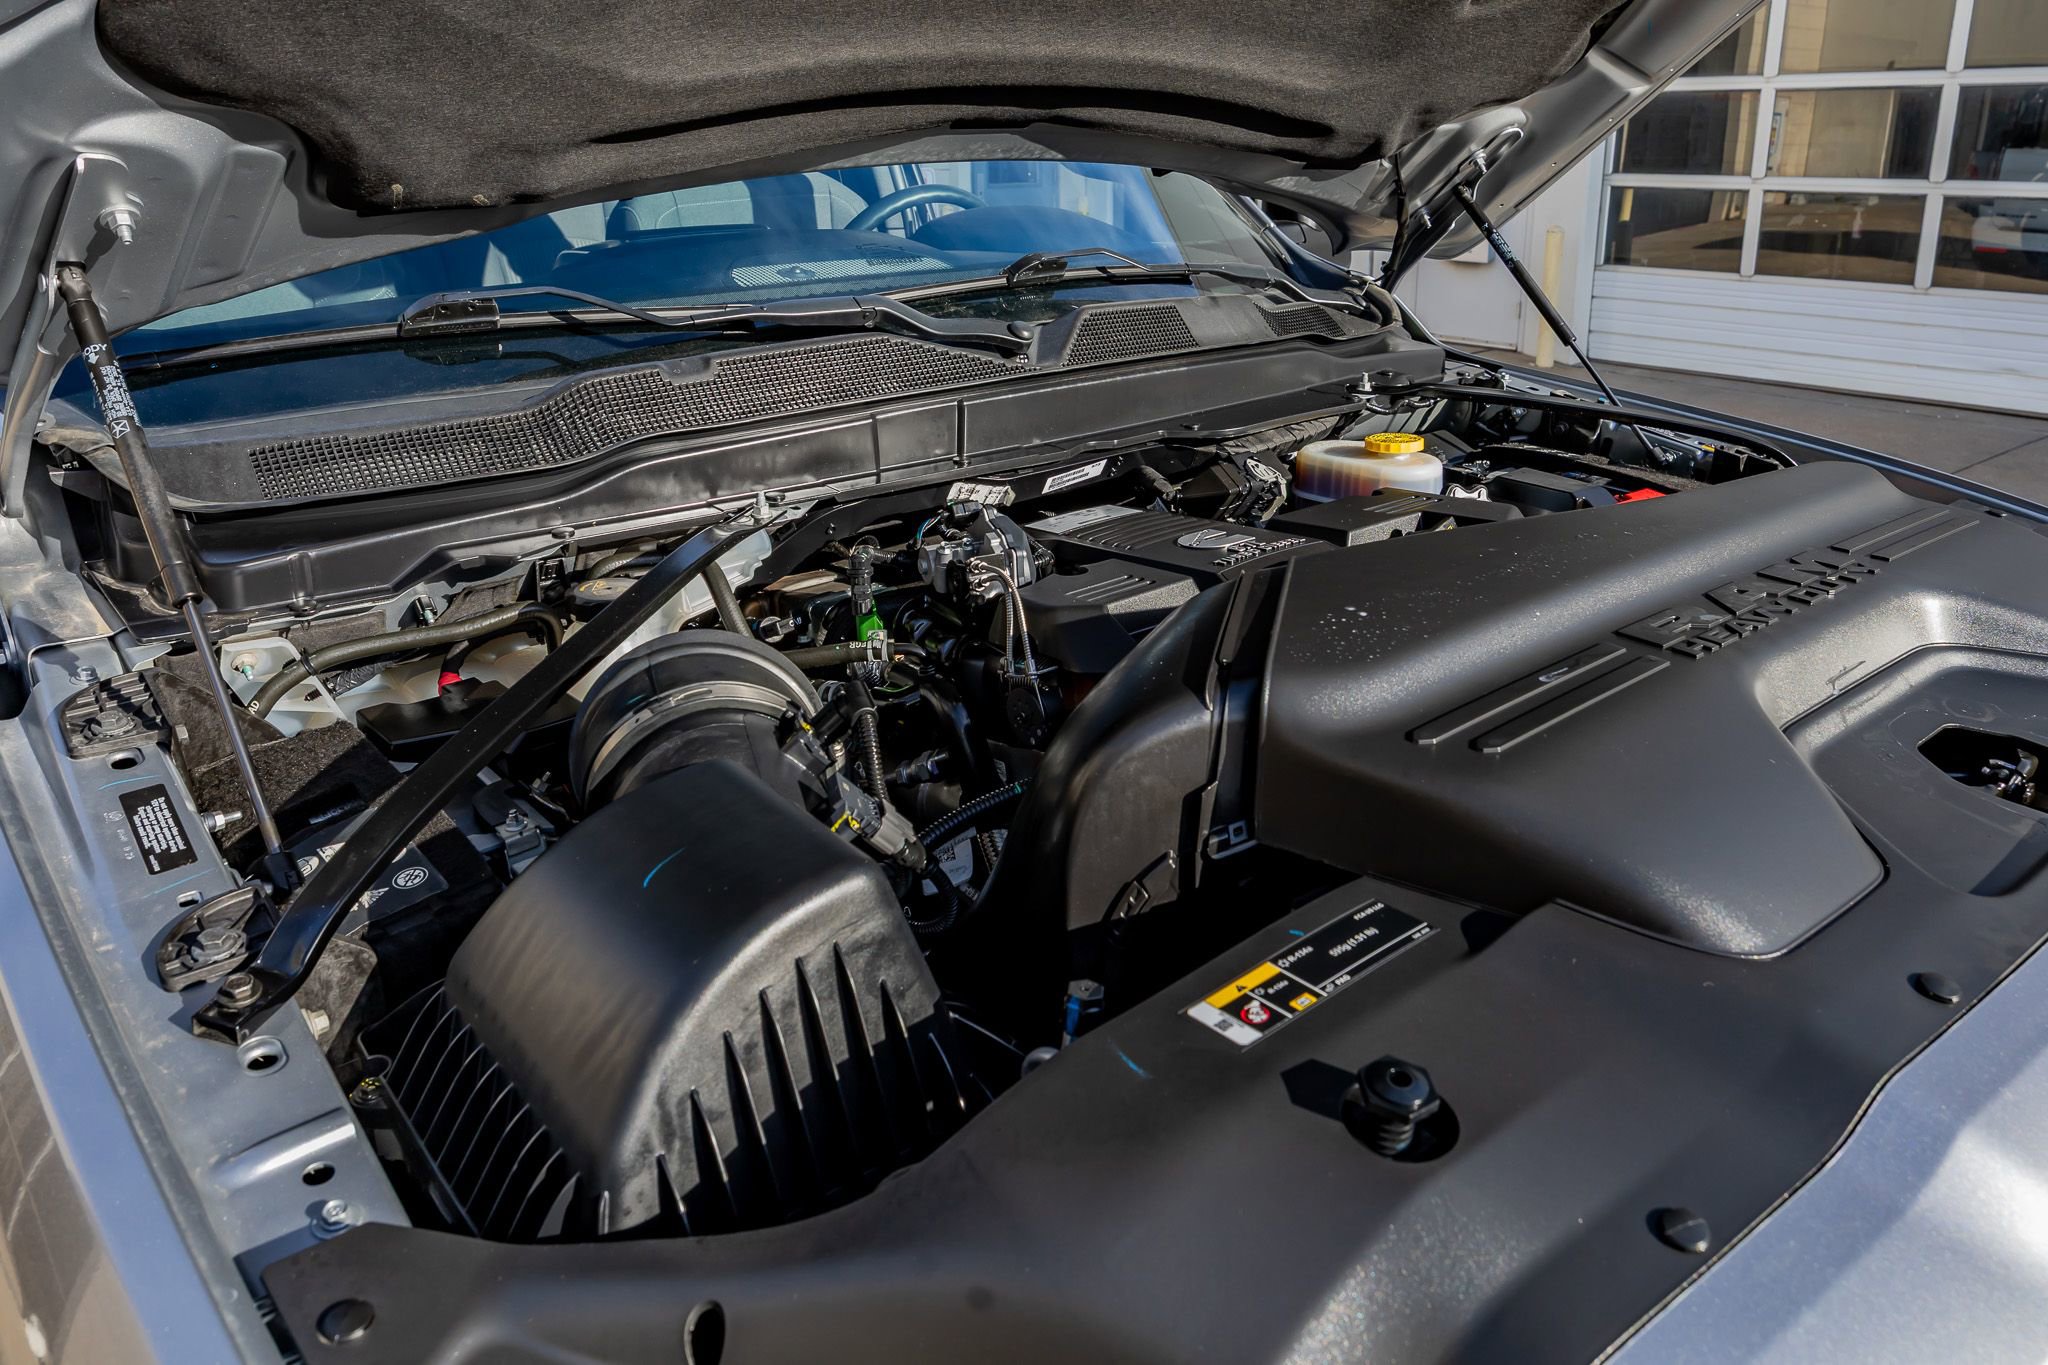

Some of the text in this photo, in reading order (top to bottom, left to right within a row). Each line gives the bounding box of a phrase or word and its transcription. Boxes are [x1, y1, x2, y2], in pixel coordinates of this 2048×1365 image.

[83, 343, 108, 356] ODY
[1612, 551, 1856, 650] RAM
[1670, 563, 1881, 660] HEAVY DUTY
